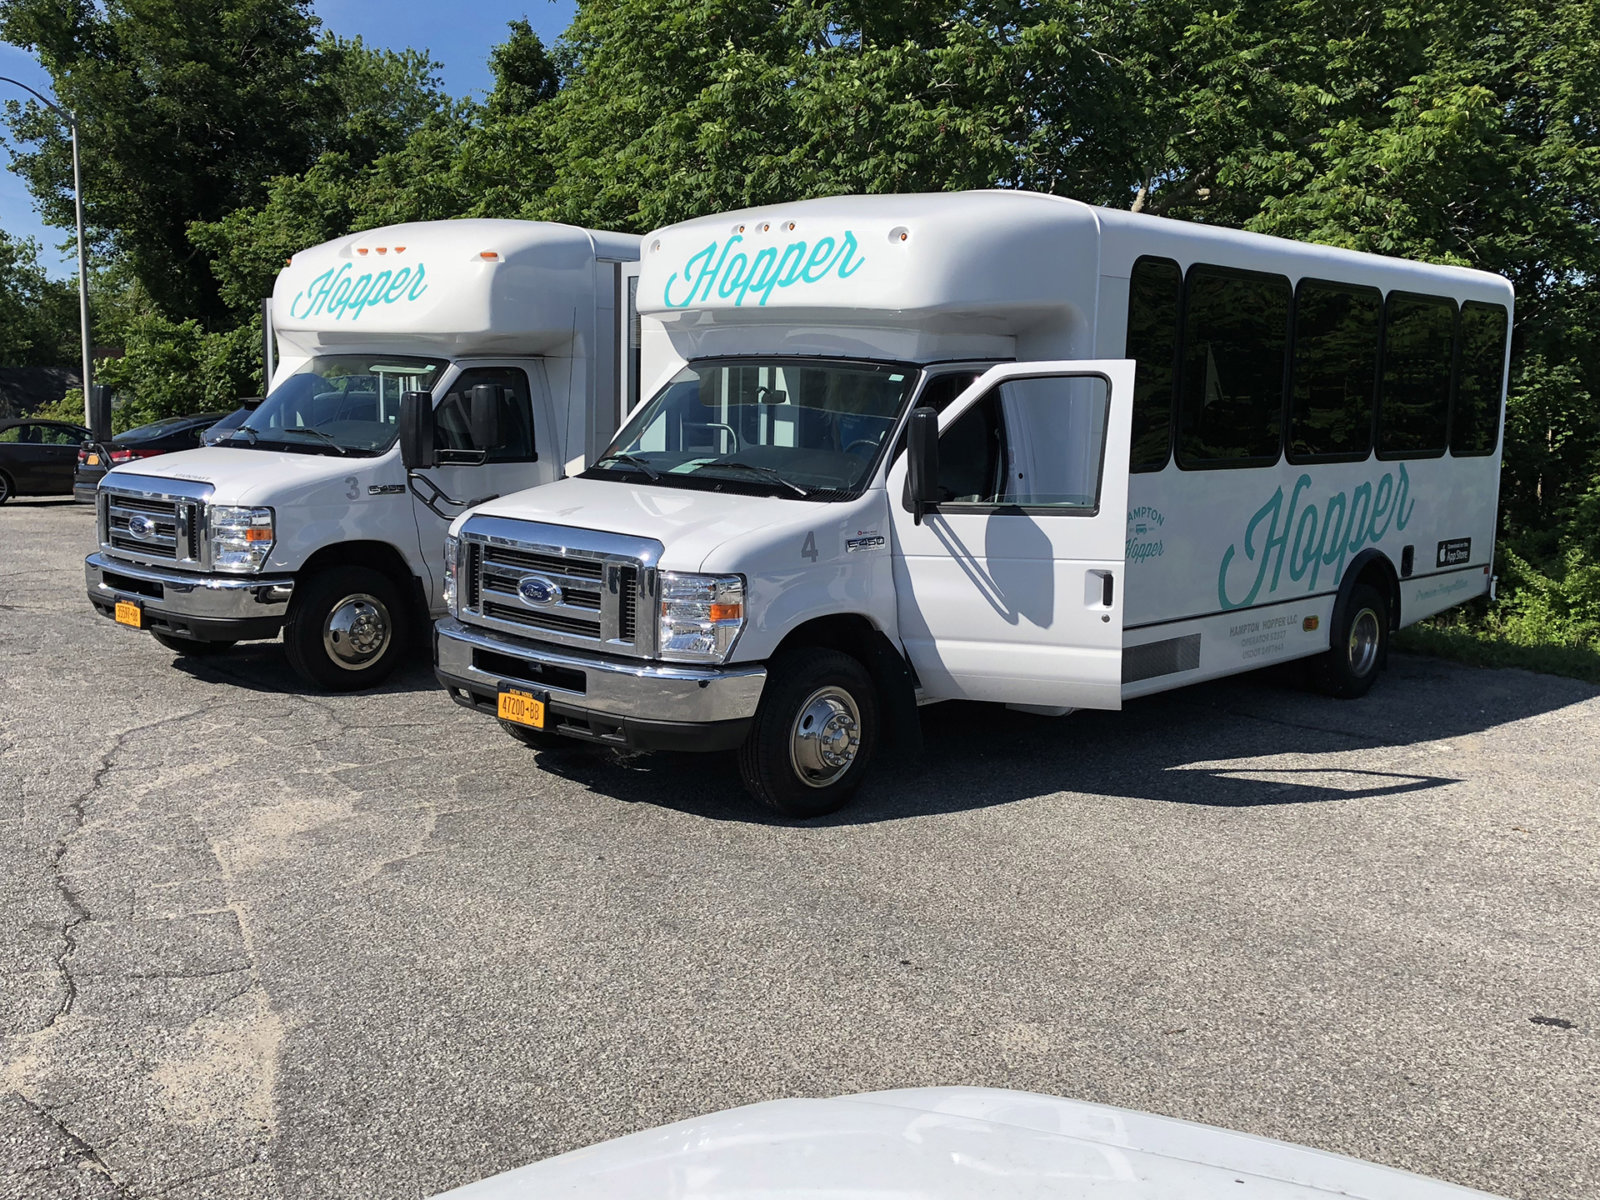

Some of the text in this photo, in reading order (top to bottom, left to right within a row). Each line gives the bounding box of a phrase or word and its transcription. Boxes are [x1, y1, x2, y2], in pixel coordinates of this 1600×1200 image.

[664, 230, 866, 307] Hopper
[290, 262, 428, 320] Hopper
[344, 476, 360, 500] 3
[1127, 506, 1165, 527] AMPTON
[800, 530, 819, 562] 4
[1218, 463, 1415, 610] Hopper
[1126, 537, 1164, 564] Hopper
[1446, 549, 1468, 563] App Store
[1229, 614, 1298, 637] HAMPTON HOPPER LLC
